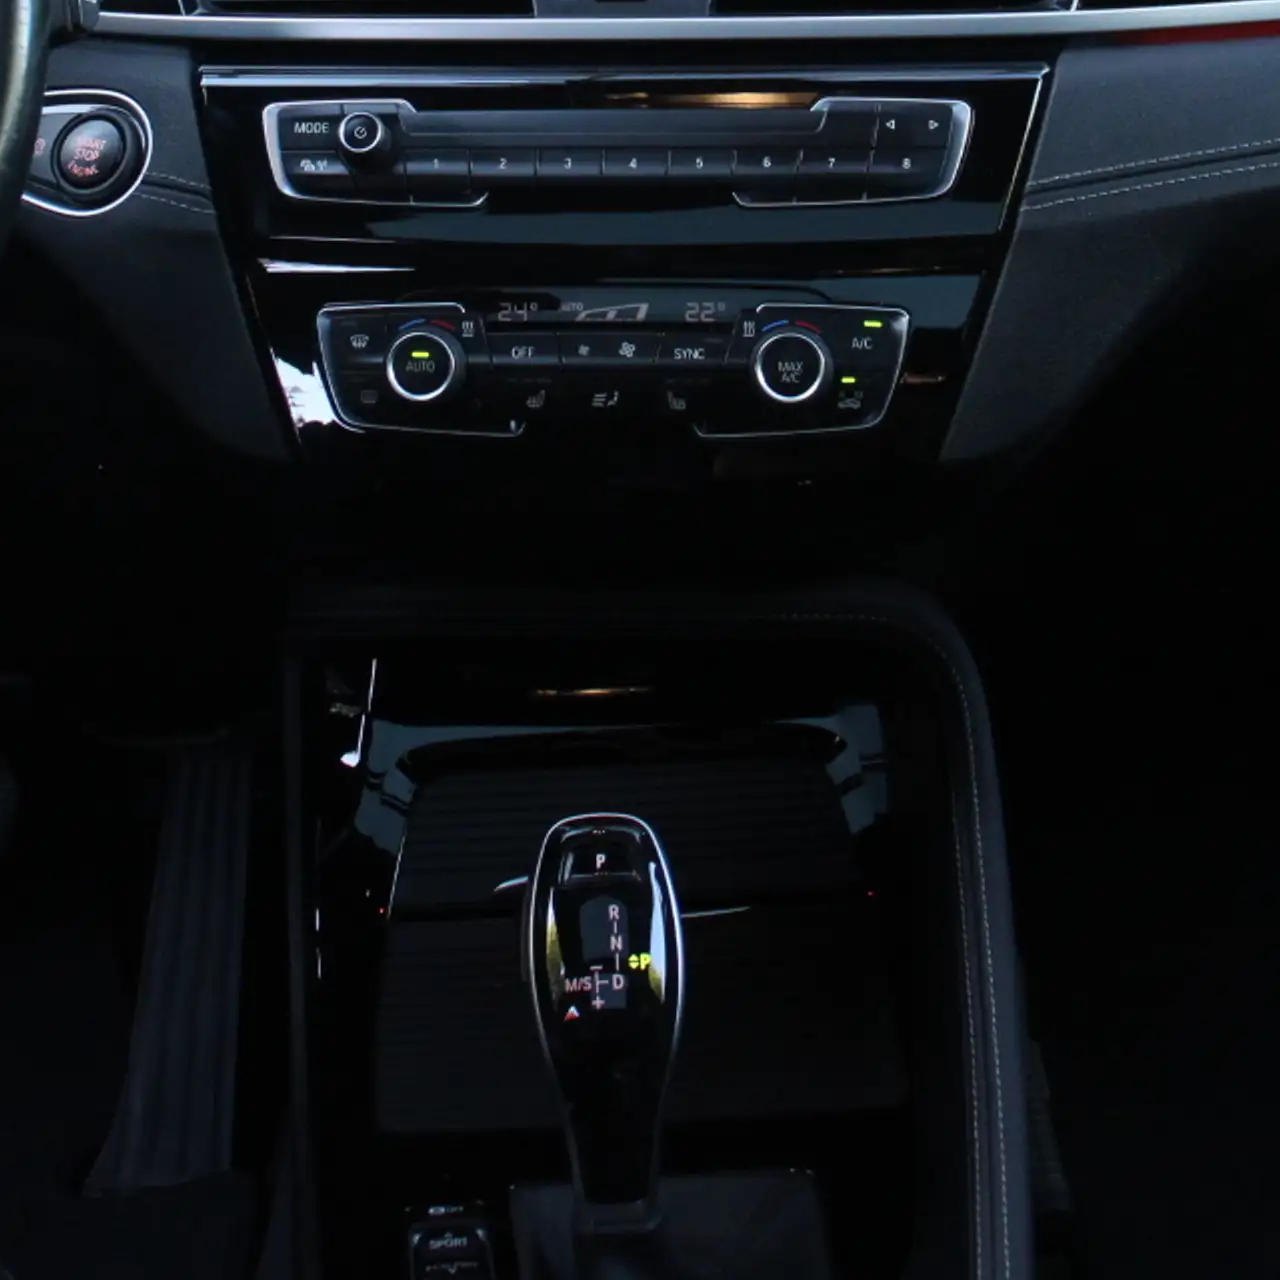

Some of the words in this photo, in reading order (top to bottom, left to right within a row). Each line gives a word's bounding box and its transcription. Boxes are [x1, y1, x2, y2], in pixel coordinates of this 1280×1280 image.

[293, 121, 330, 135] MODE
[74, 147, 100, 162] STOP
[432, 158, 440, 169] 1
[498, 158, 508, 170] 2
[563, 157, 572, 169] 3
[628, 157, 638, 169] 4
[695, 157, 704, 169] 5
[762, 156, 772, 168] 6
[827, 157, 837, 169] 7
[901, 157, 912, 169] 8
[851, 337, 873, 350] A/C
[510, 346, 536, 360] OFF
[673, 347, 707, 361] SYNC
[405, 361, 436, 375] AUTO
[777, 361, 804, 373] MAX
[779, 372, 801, 385] A/C
[595, 853, 608, 870] P
[608, 904, 621, 921] R
[610, 935, 624, 952] N
[639, 953, 652, 971] P
[564, 977, 594, 993] M/S
[612, 973, 626, 990] D
